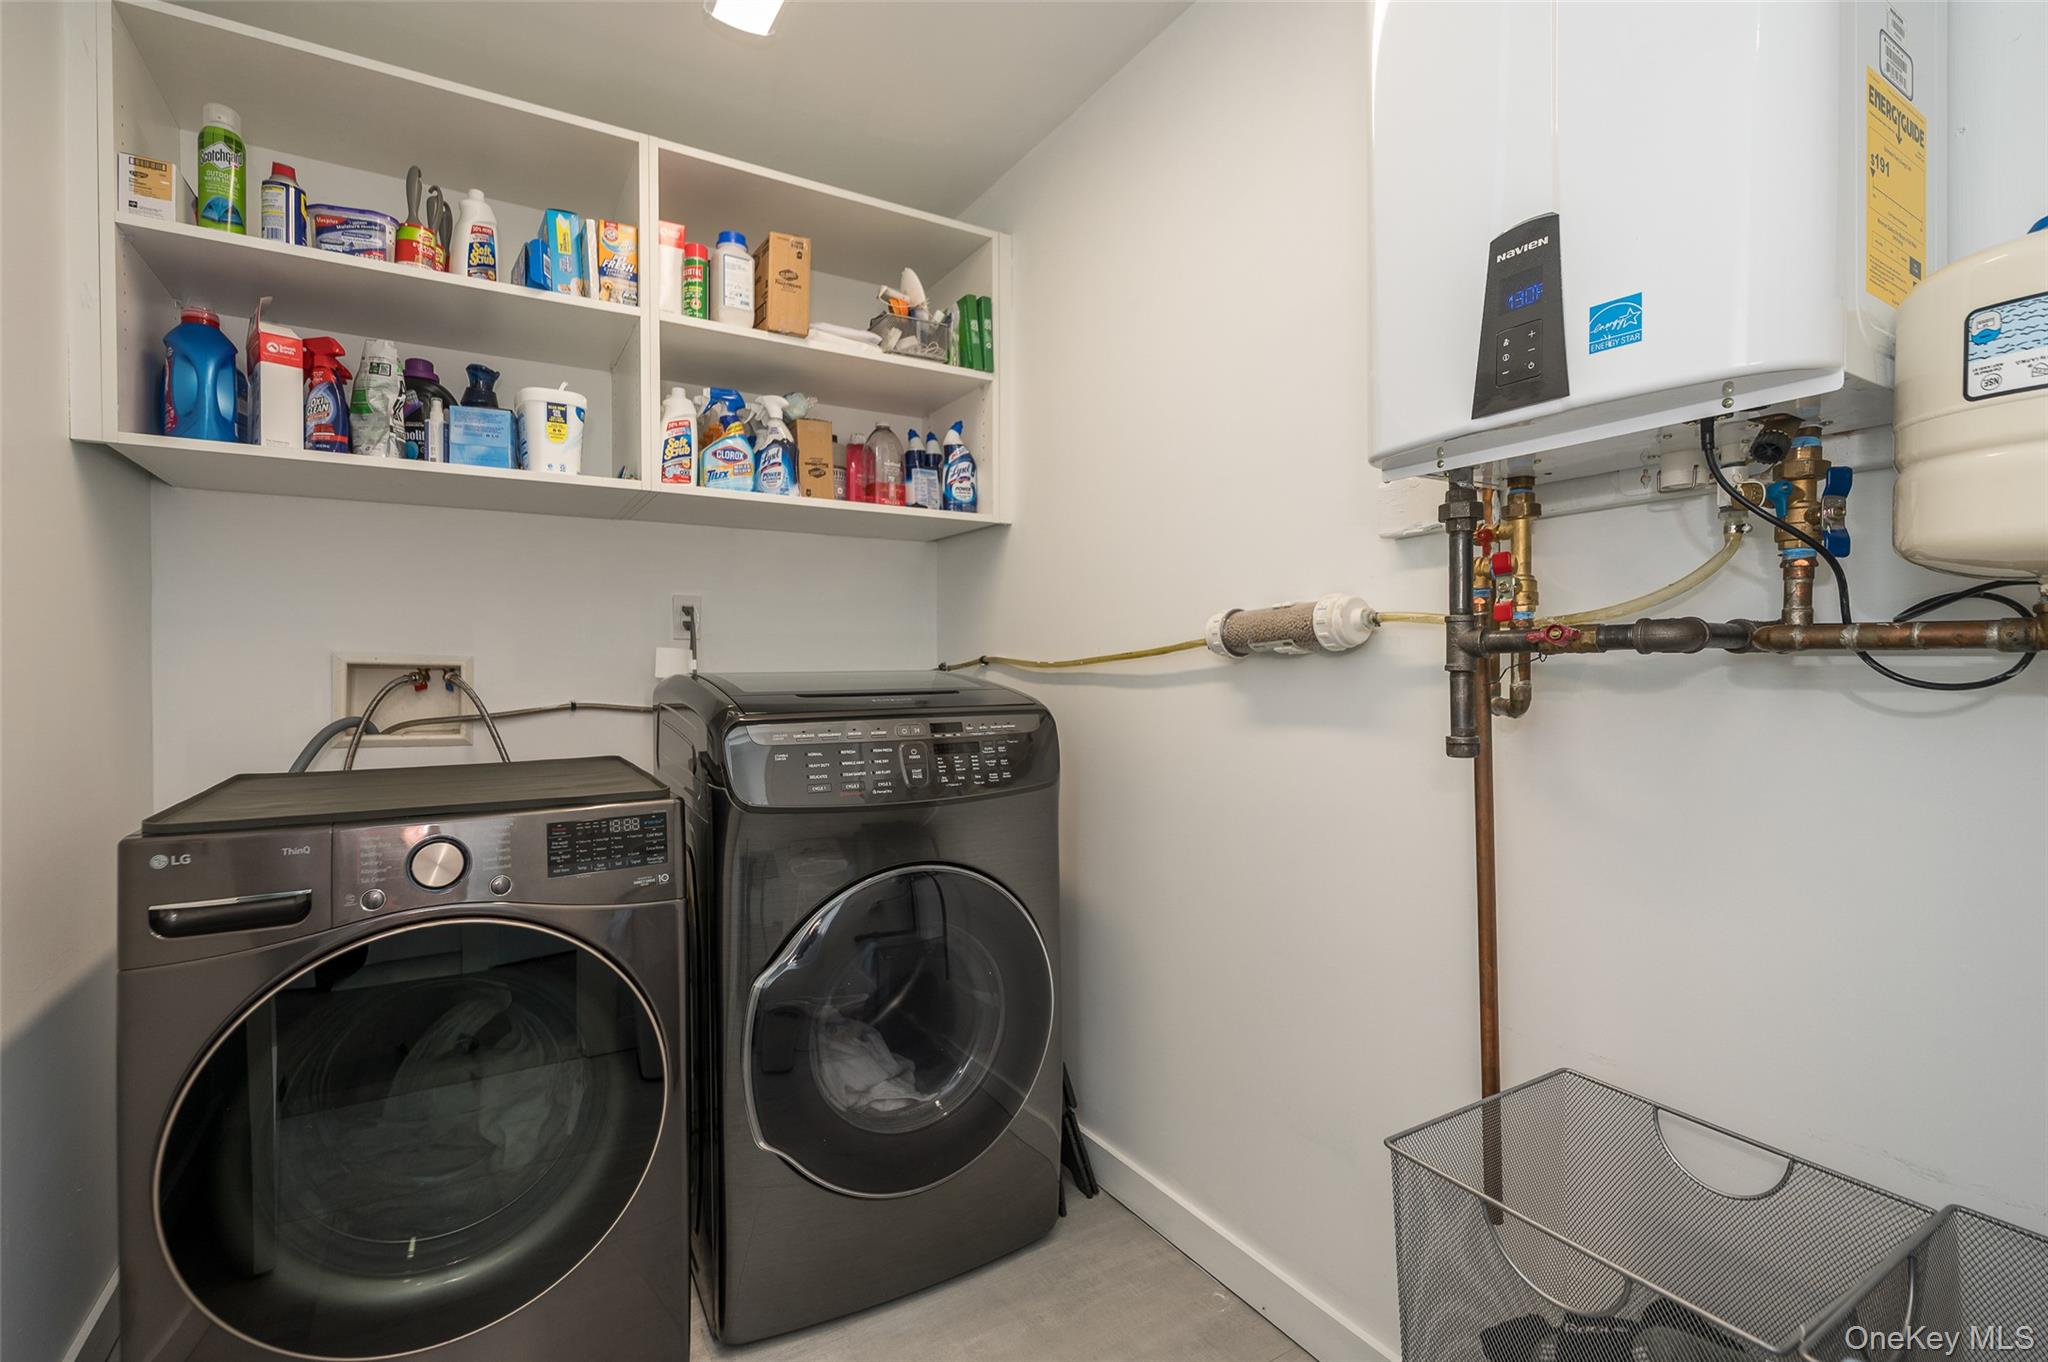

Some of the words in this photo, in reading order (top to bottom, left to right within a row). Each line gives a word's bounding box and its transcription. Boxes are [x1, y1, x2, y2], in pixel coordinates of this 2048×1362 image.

[473, 243, 491, 255] Soft
[470, 252, 495, 266] Scrub
[602, 259, 634, 272] FRESH
[1590, 338, 1620, 352] ENERGY
[1621, 332, 1641, 344] STAR
[307, 404, 329, 416] CLEAN
[667, 438, 688, 449] Soft
[664, 446, 690, 460] Scrub
[716, 450, 744, 460] CLOROX
[762, 448, 780, 466] Lysol
[951, 464, 971, 476] Lysol
[282, 845, 311, 856] ThinQ
[171, 854, 192, 866] LG
